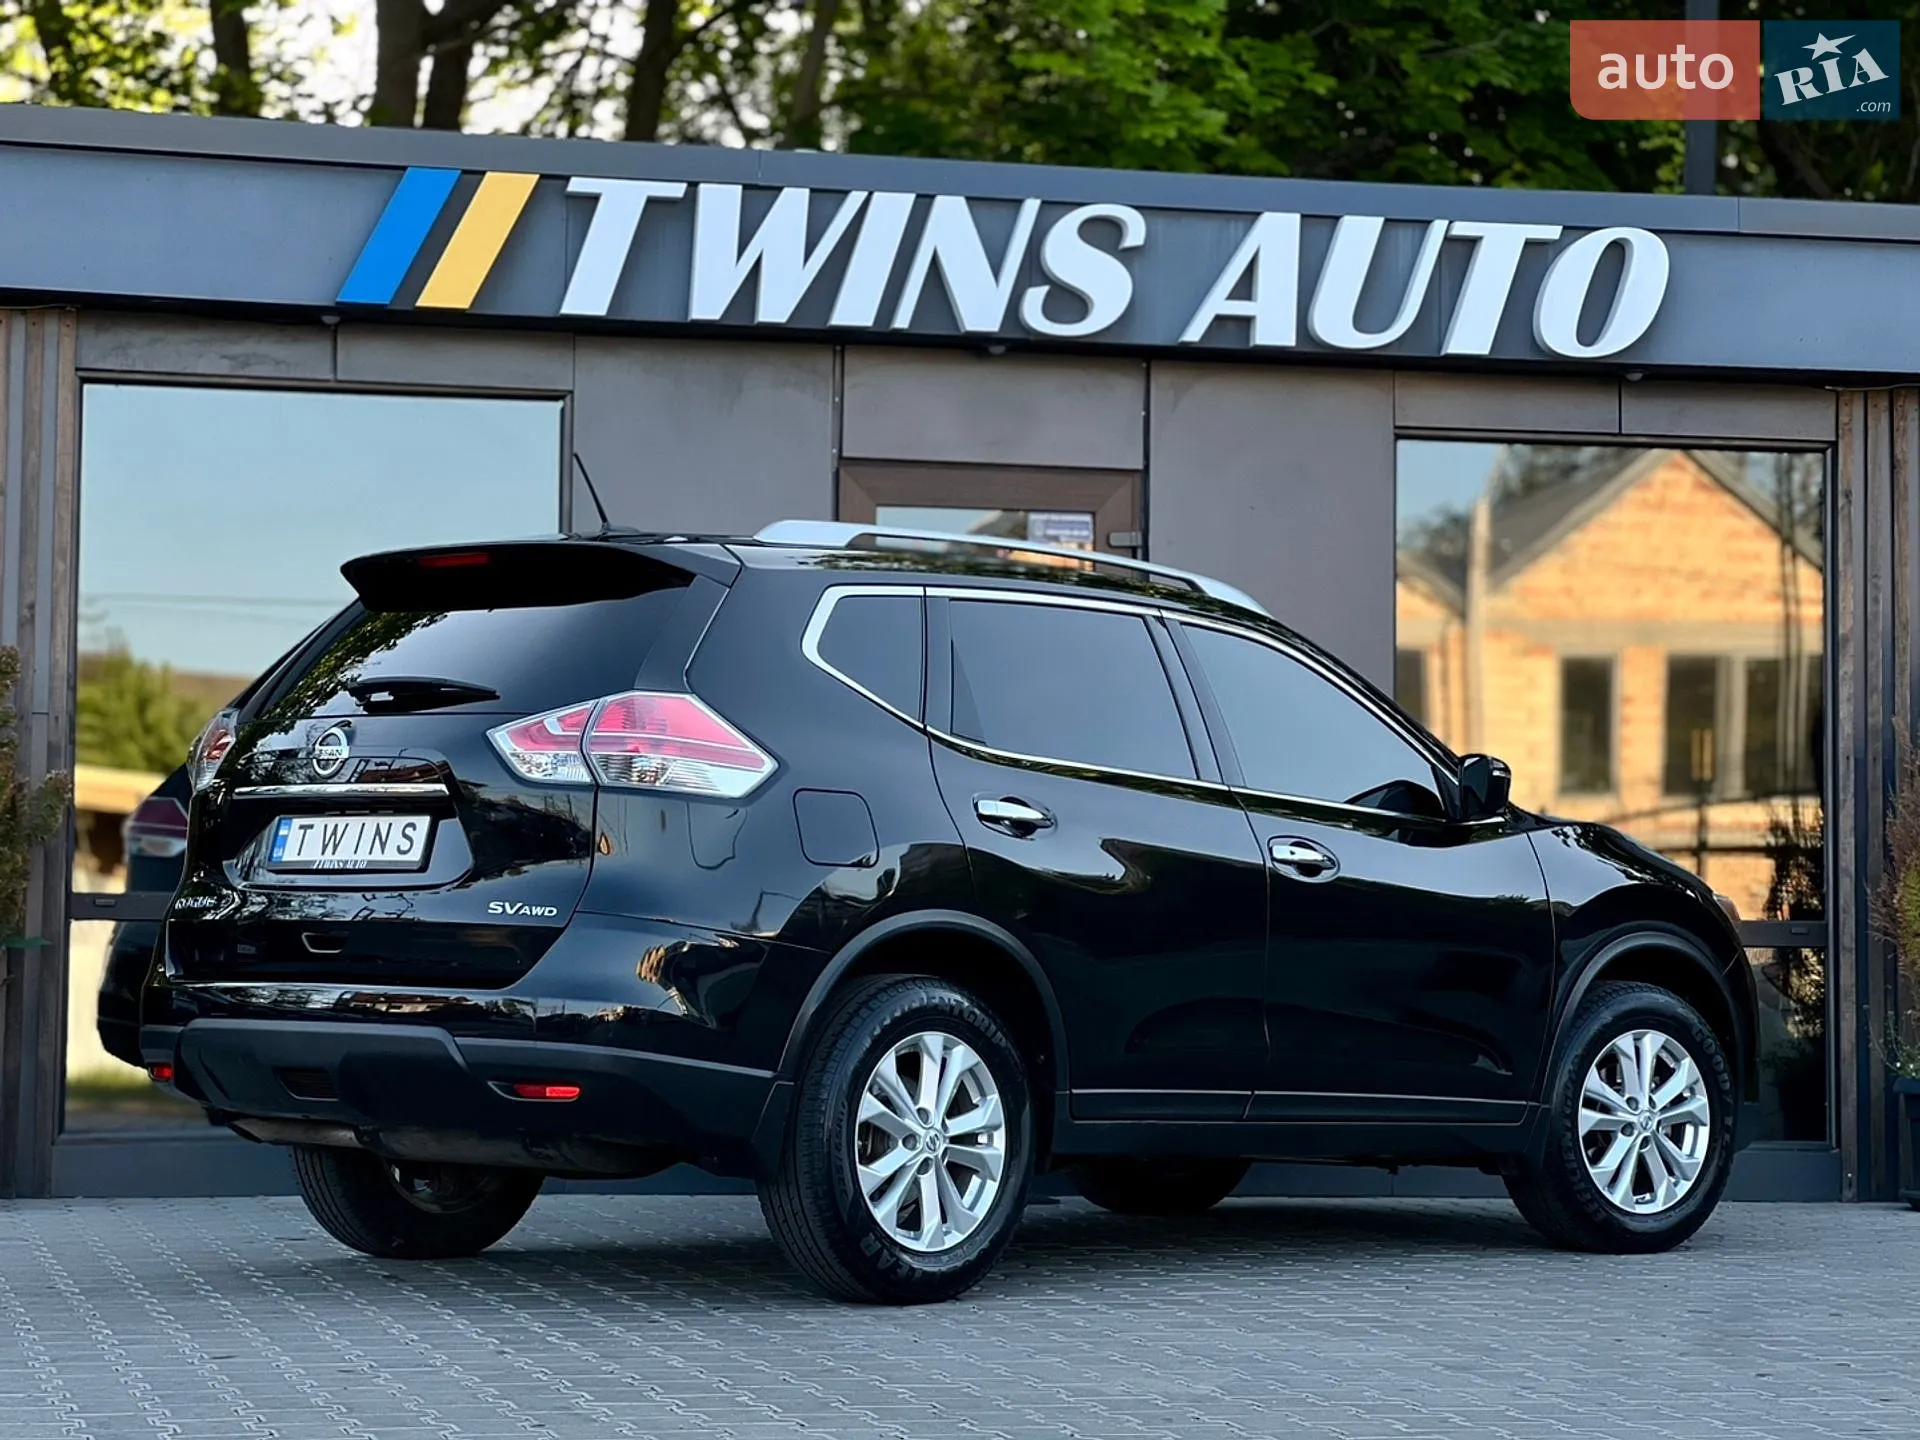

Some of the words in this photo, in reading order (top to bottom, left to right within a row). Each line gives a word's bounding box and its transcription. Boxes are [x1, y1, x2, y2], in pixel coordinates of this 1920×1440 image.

[559, 176, 1147, 337] TWINS
[1178, 211, 1670, 358] AUTO
[297, 822, 417, 856] TWINS
